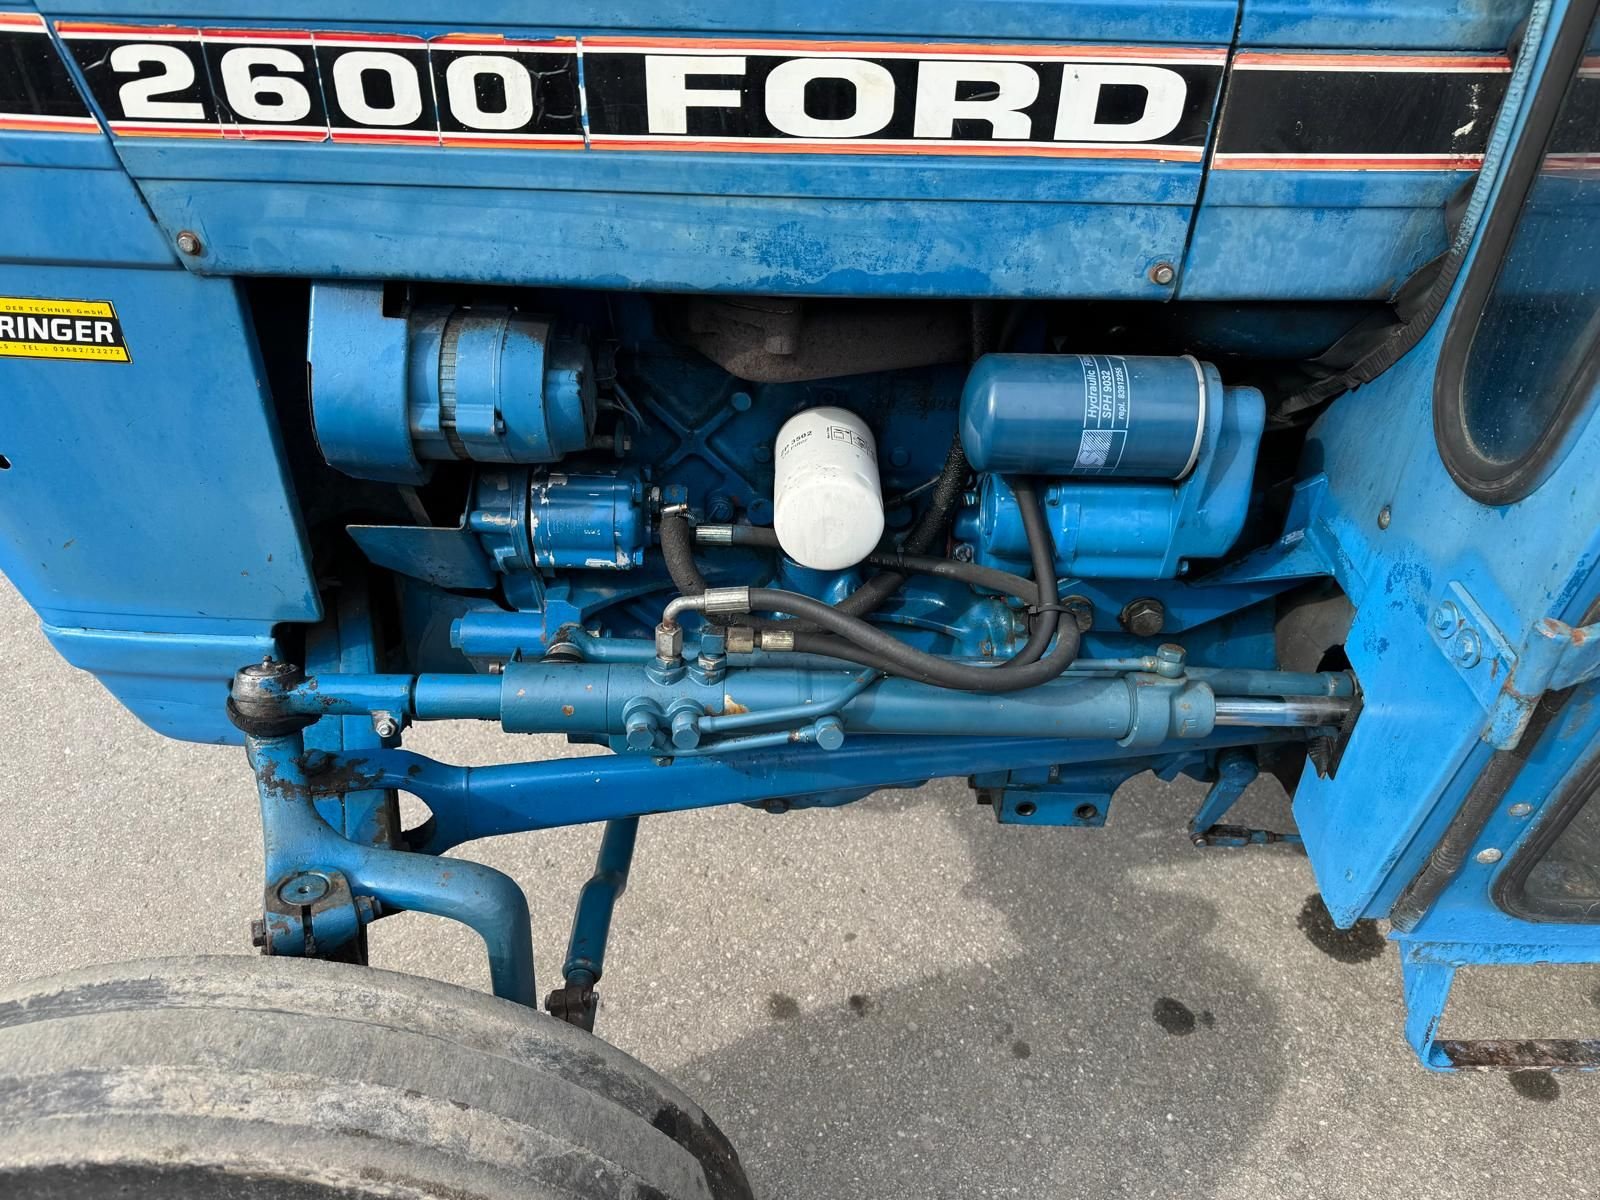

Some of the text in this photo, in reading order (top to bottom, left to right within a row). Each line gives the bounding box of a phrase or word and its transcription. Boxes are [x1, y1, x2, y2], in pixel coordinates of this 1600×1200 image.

[110, 43, 1188, 142] 2600 FORD
[0, 315, 115, 343] RINGER
[1087, 369, 1101, 418] Hydraulic
[1101, 370, 1112, 419] SPH 9032
